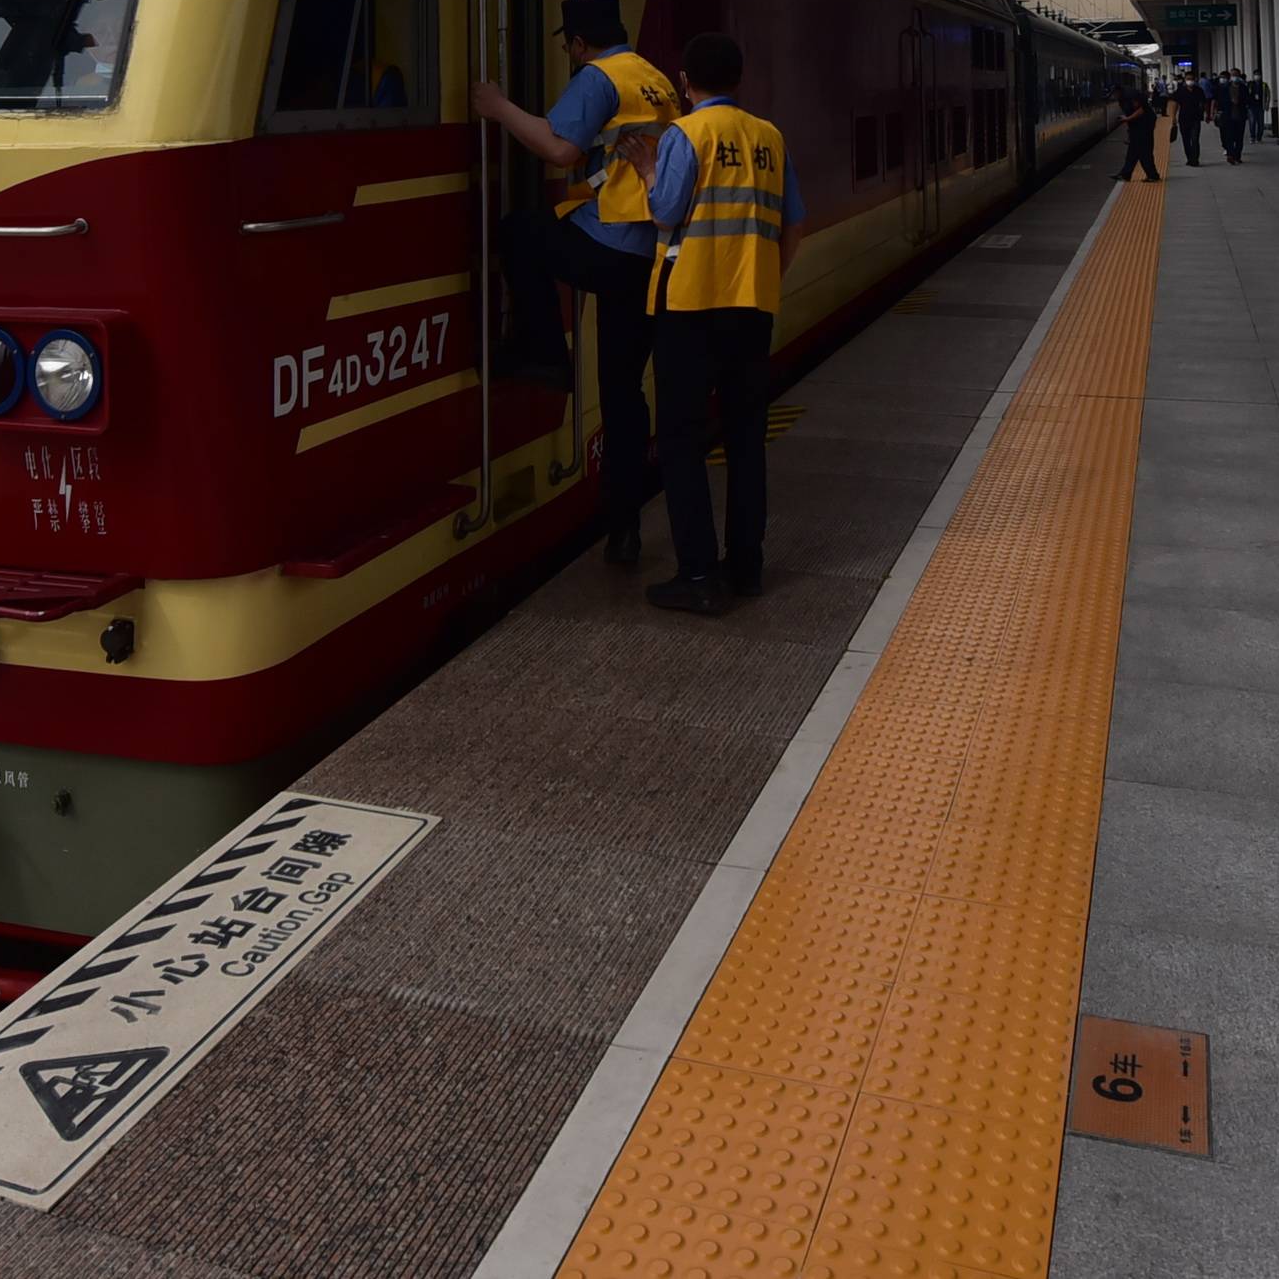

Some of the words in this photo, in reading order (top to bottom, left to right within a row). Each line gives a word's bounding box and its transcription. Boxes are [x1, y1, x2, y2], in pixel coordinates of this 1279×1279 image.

[716, 140, 774, 172] 牡机
[273, 311, 450, 419] DF4D3247
[25, 445, 101, 480] 电化区段
[31, 498, 107, 535] 严禁攀登
[109, 829, 354, 1024] 小心站台间隙
[1092, 1053, 1143, 1103] 6车
